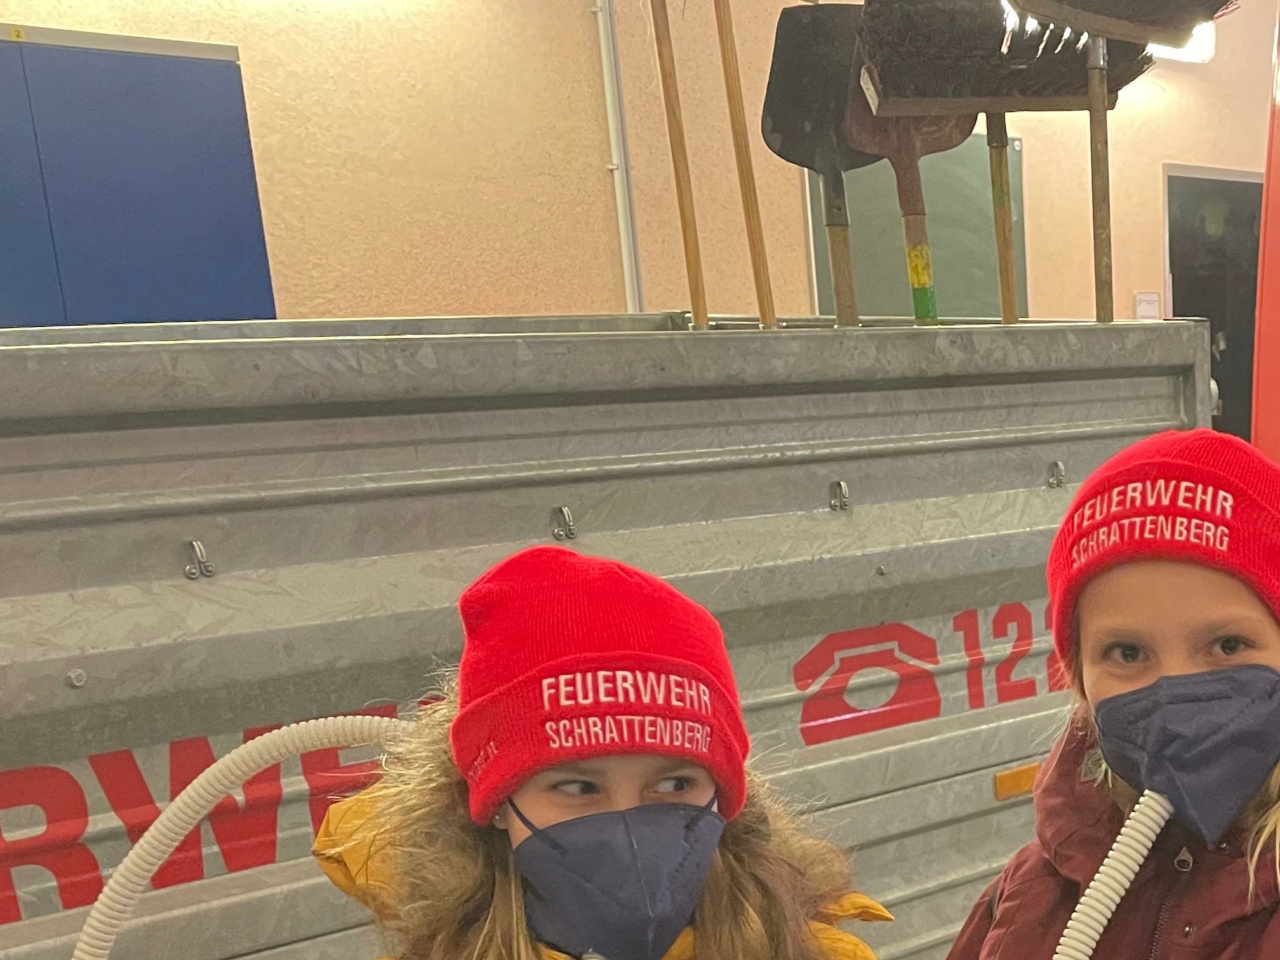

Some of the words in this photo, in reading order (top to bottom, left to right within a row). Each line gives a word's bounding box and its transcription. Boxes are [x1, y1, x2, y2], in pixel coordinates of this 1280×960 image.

[1072, 478, 1234, 533] FEUERWEHR
[1071, 515, 1230, 569] SCHRATTENBERG
[541, 670, 712, 715] FEUERWEHR
[545, 715, 711, 753] SCHRATTENBERG
